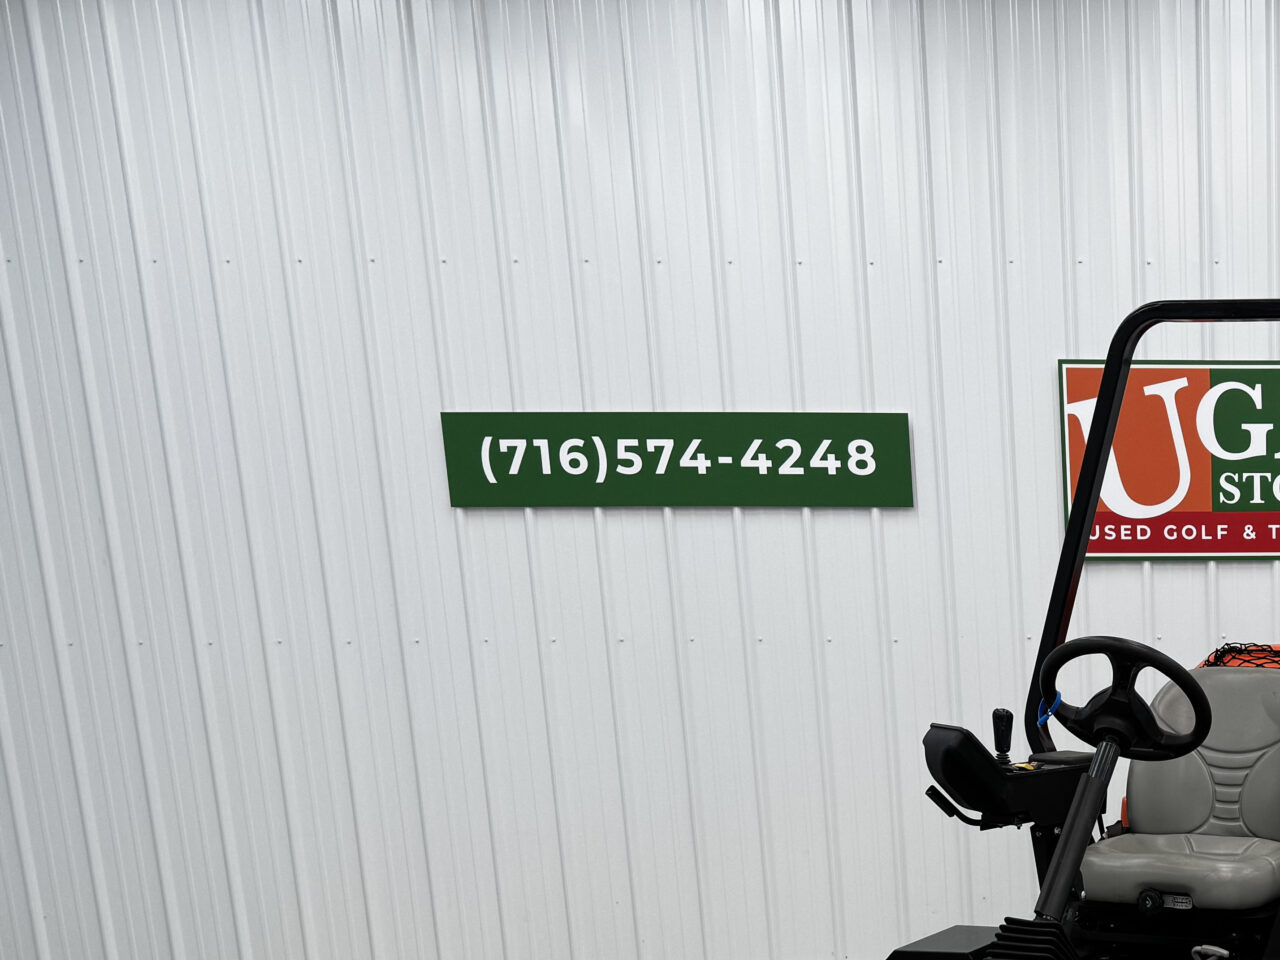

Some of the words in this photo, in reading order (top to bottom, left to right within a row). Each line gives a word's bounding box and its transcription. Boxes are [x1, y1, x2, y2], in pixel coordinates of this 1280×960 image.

[481, 437, 877, 484] (716)574-4248
[1163, 524, 1229, 541] GOLF
[1243, 524, 1257, 540] &
